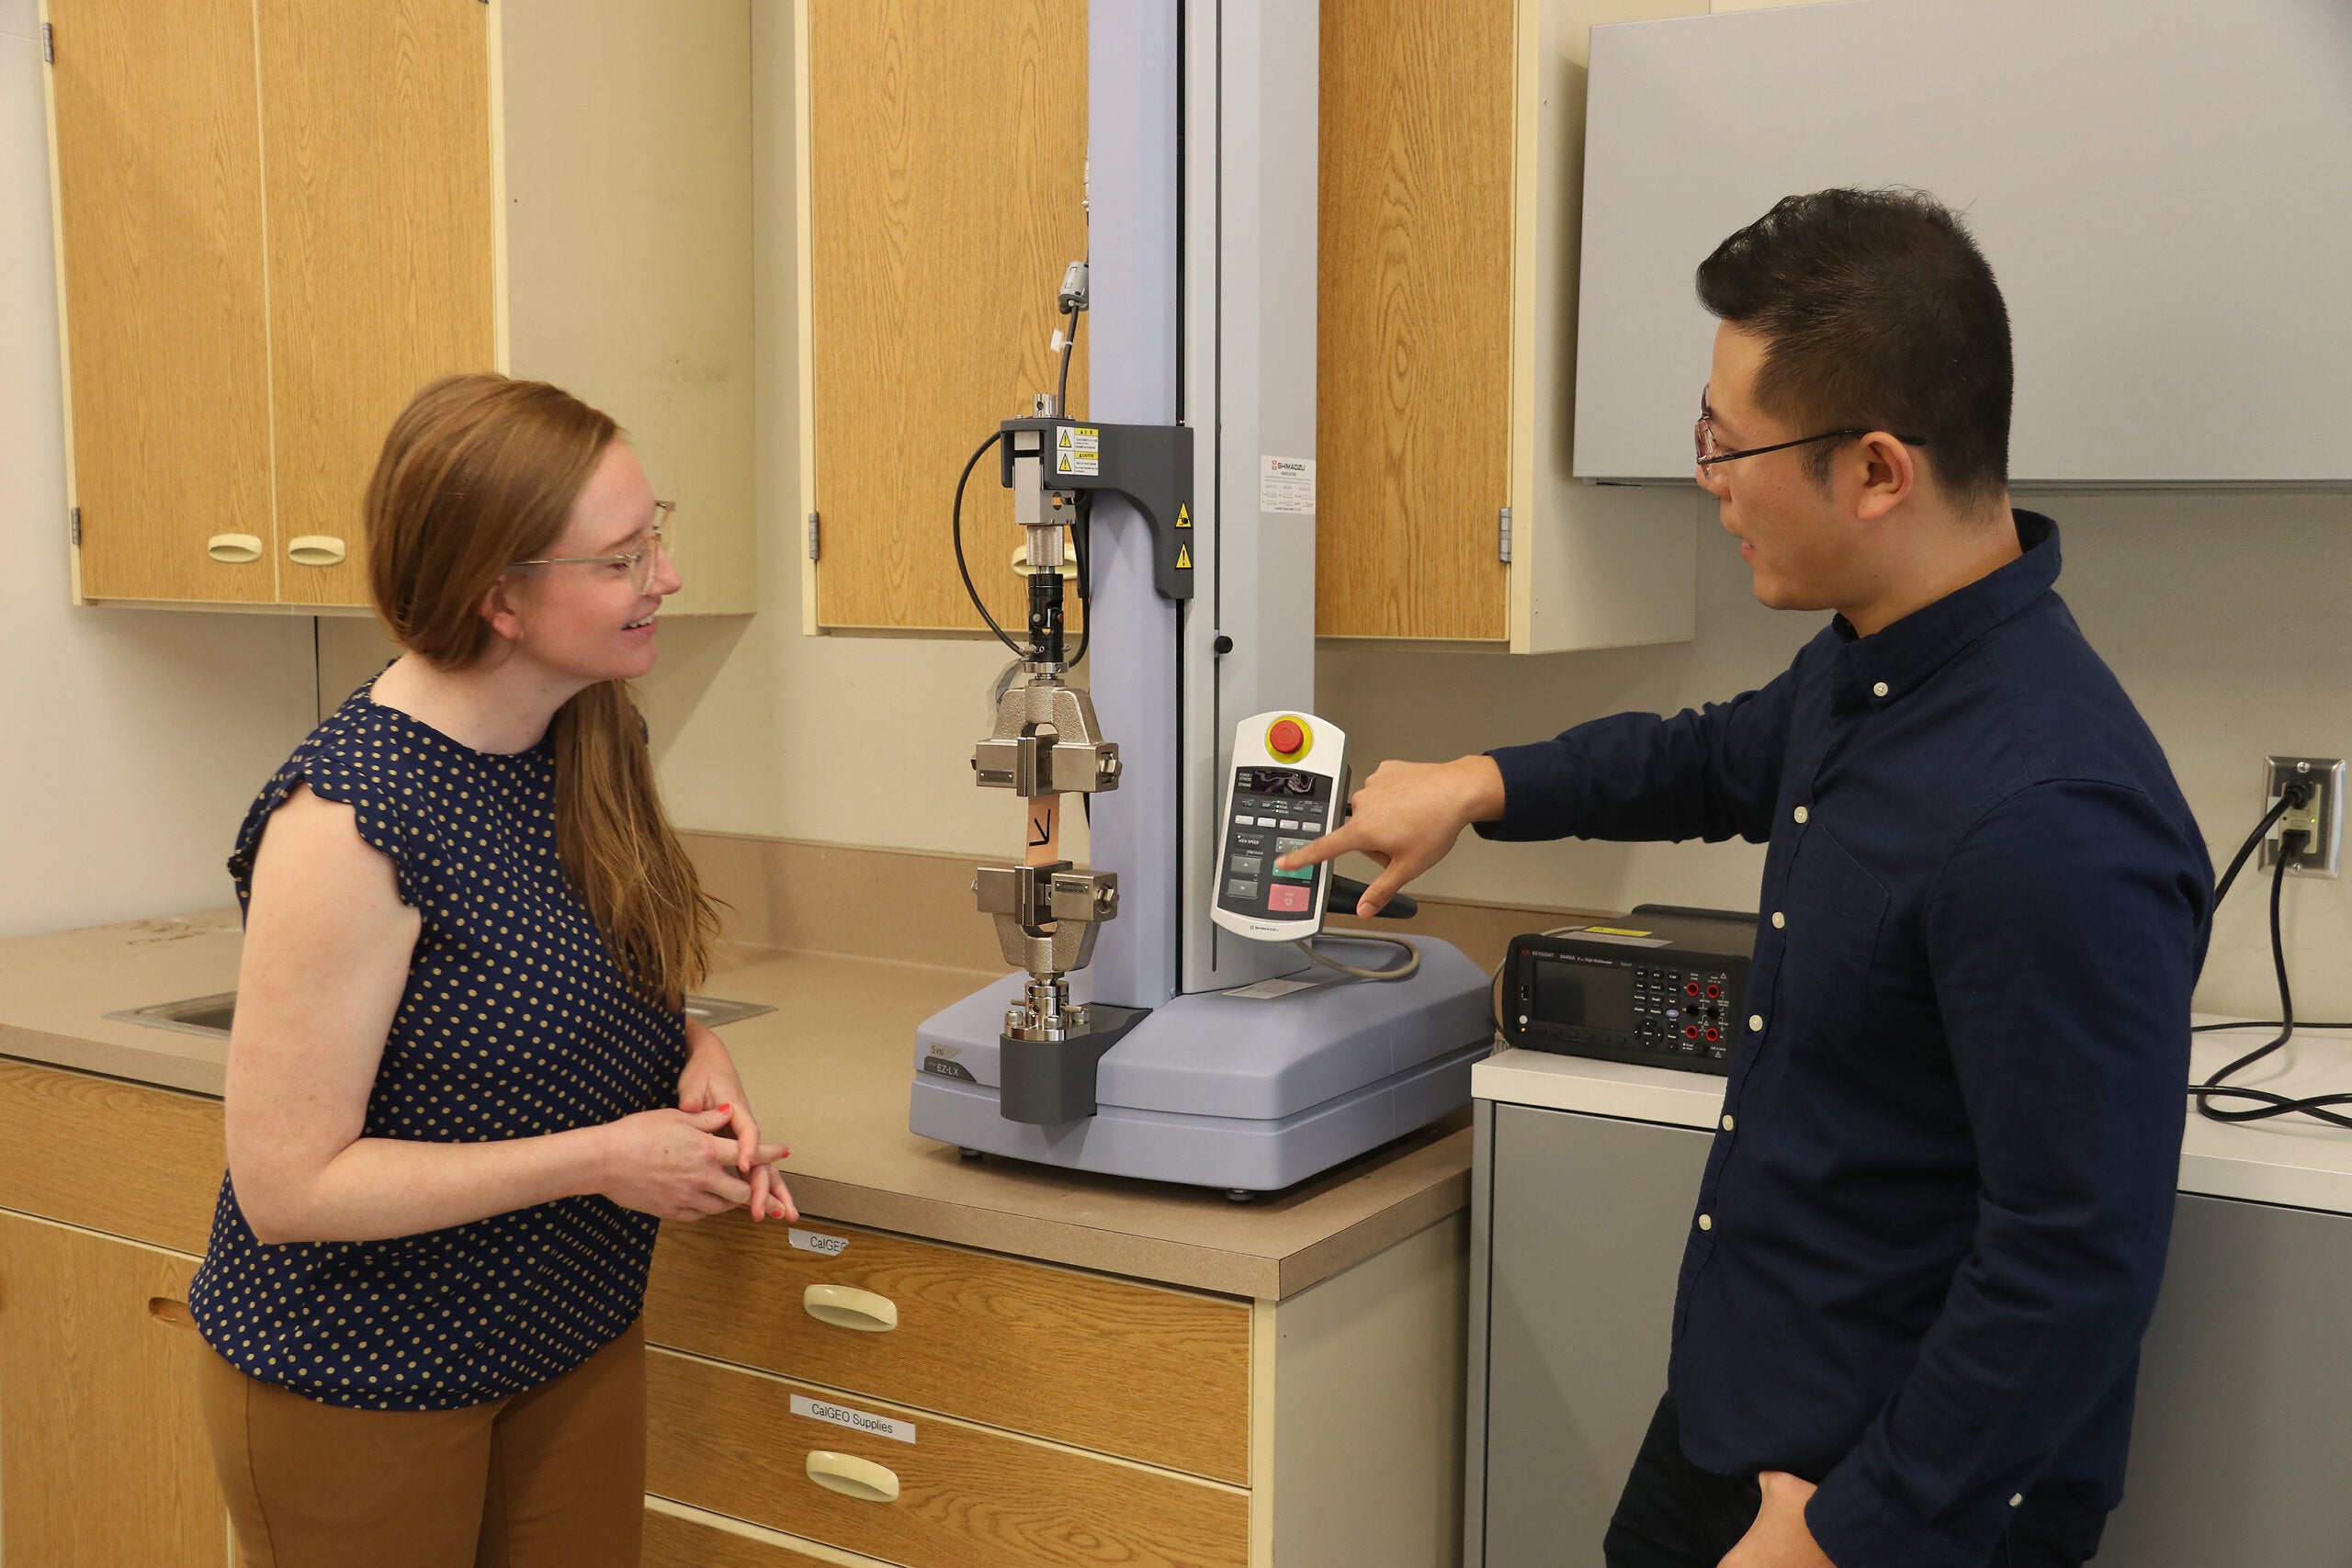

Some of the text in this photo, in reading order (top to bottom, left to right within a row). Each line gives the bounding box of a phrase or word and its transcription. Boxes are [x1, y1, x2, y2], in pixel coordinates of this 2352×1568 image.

[1277, 463, 1306, 471] SHIMADZU
[811, 1404, 893, 1433] CalGEO Supplies
